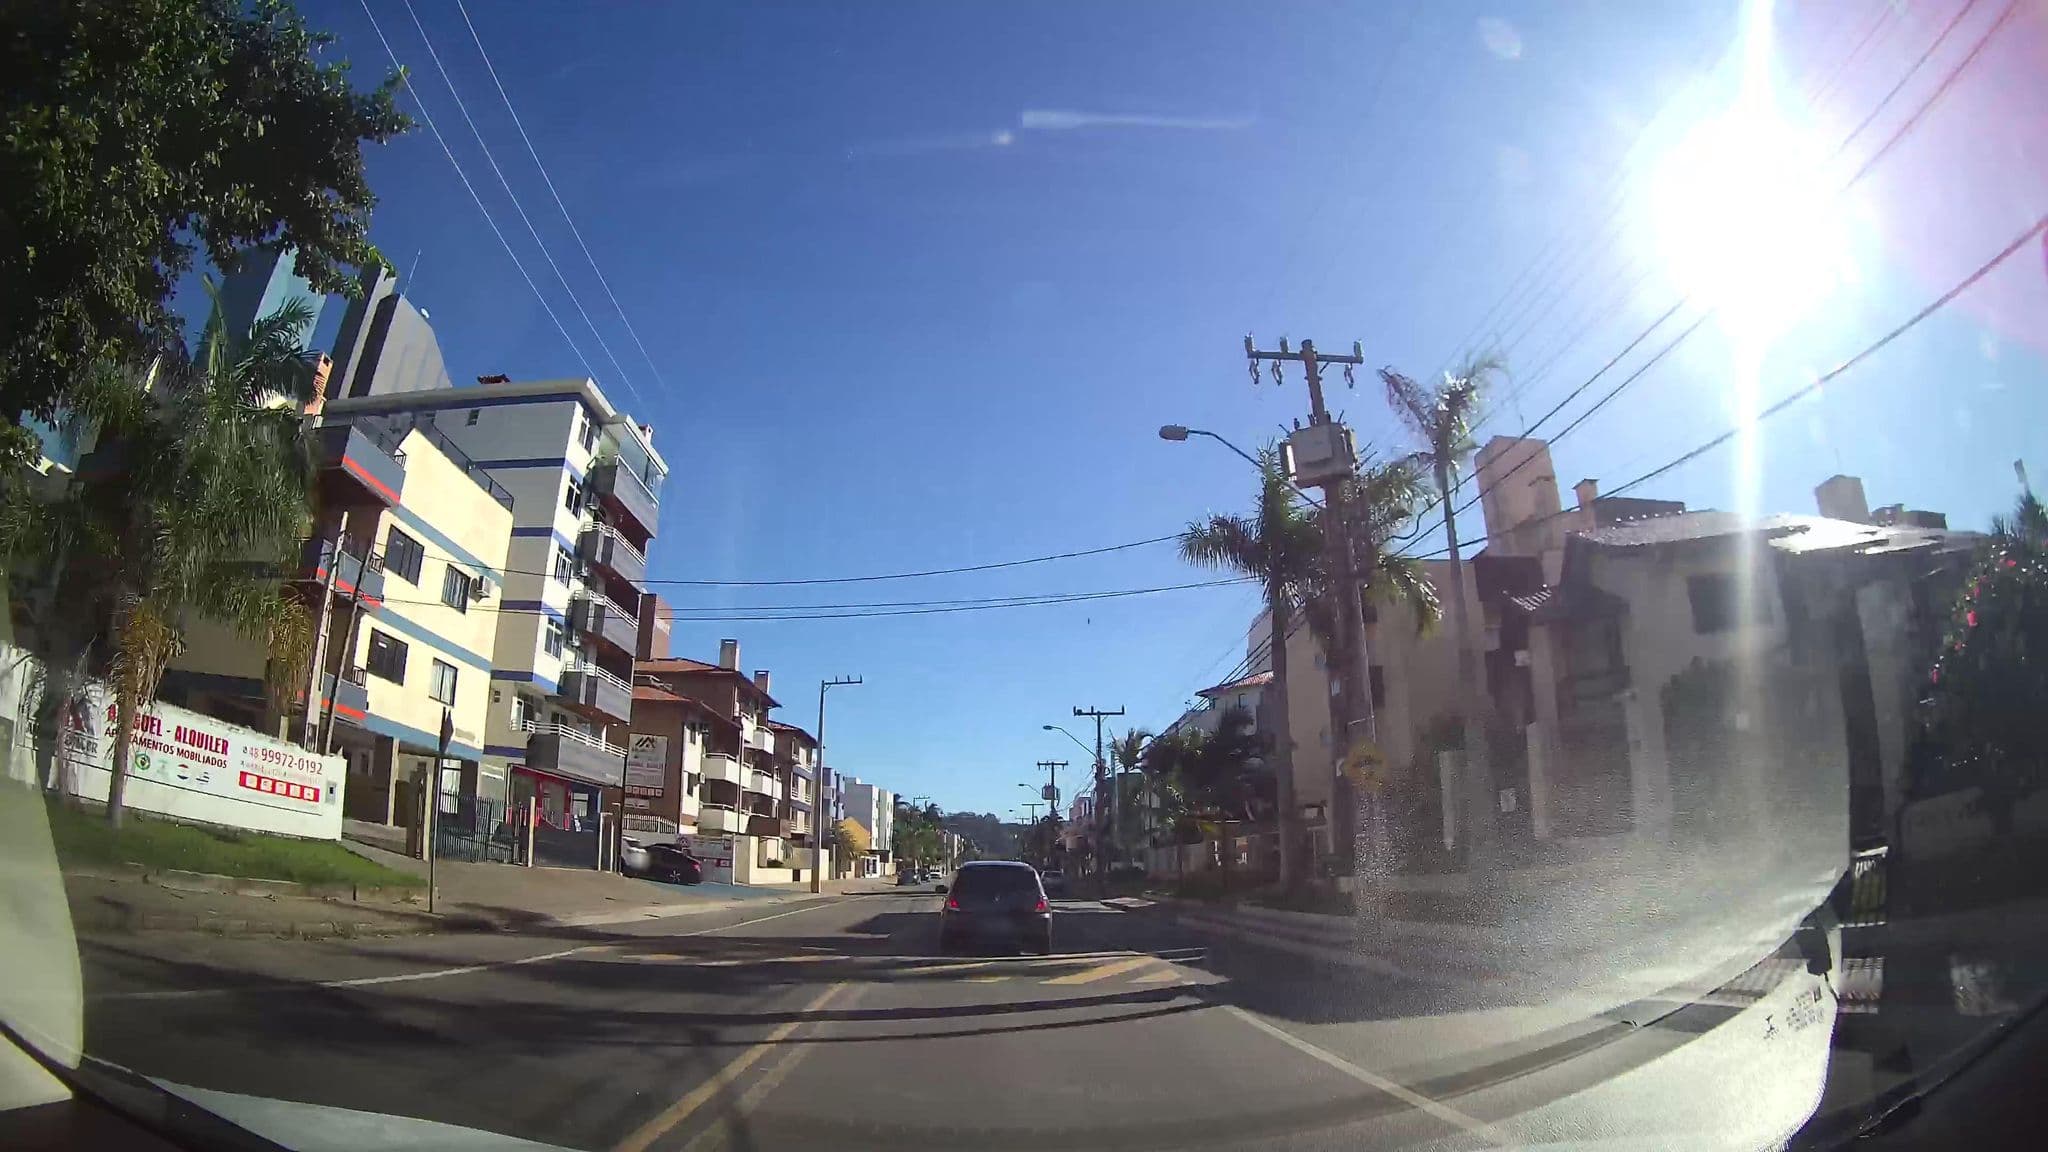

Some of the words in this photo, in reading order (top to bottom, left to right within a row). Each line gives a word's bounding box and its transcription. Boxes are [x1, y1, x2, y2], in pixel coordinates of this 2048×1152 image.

[175, 726, 230, 755] ALQUILER
[176, 748, 227, 769] MOBILIADOS
[262, 749, 324, 776] 99972-0192
